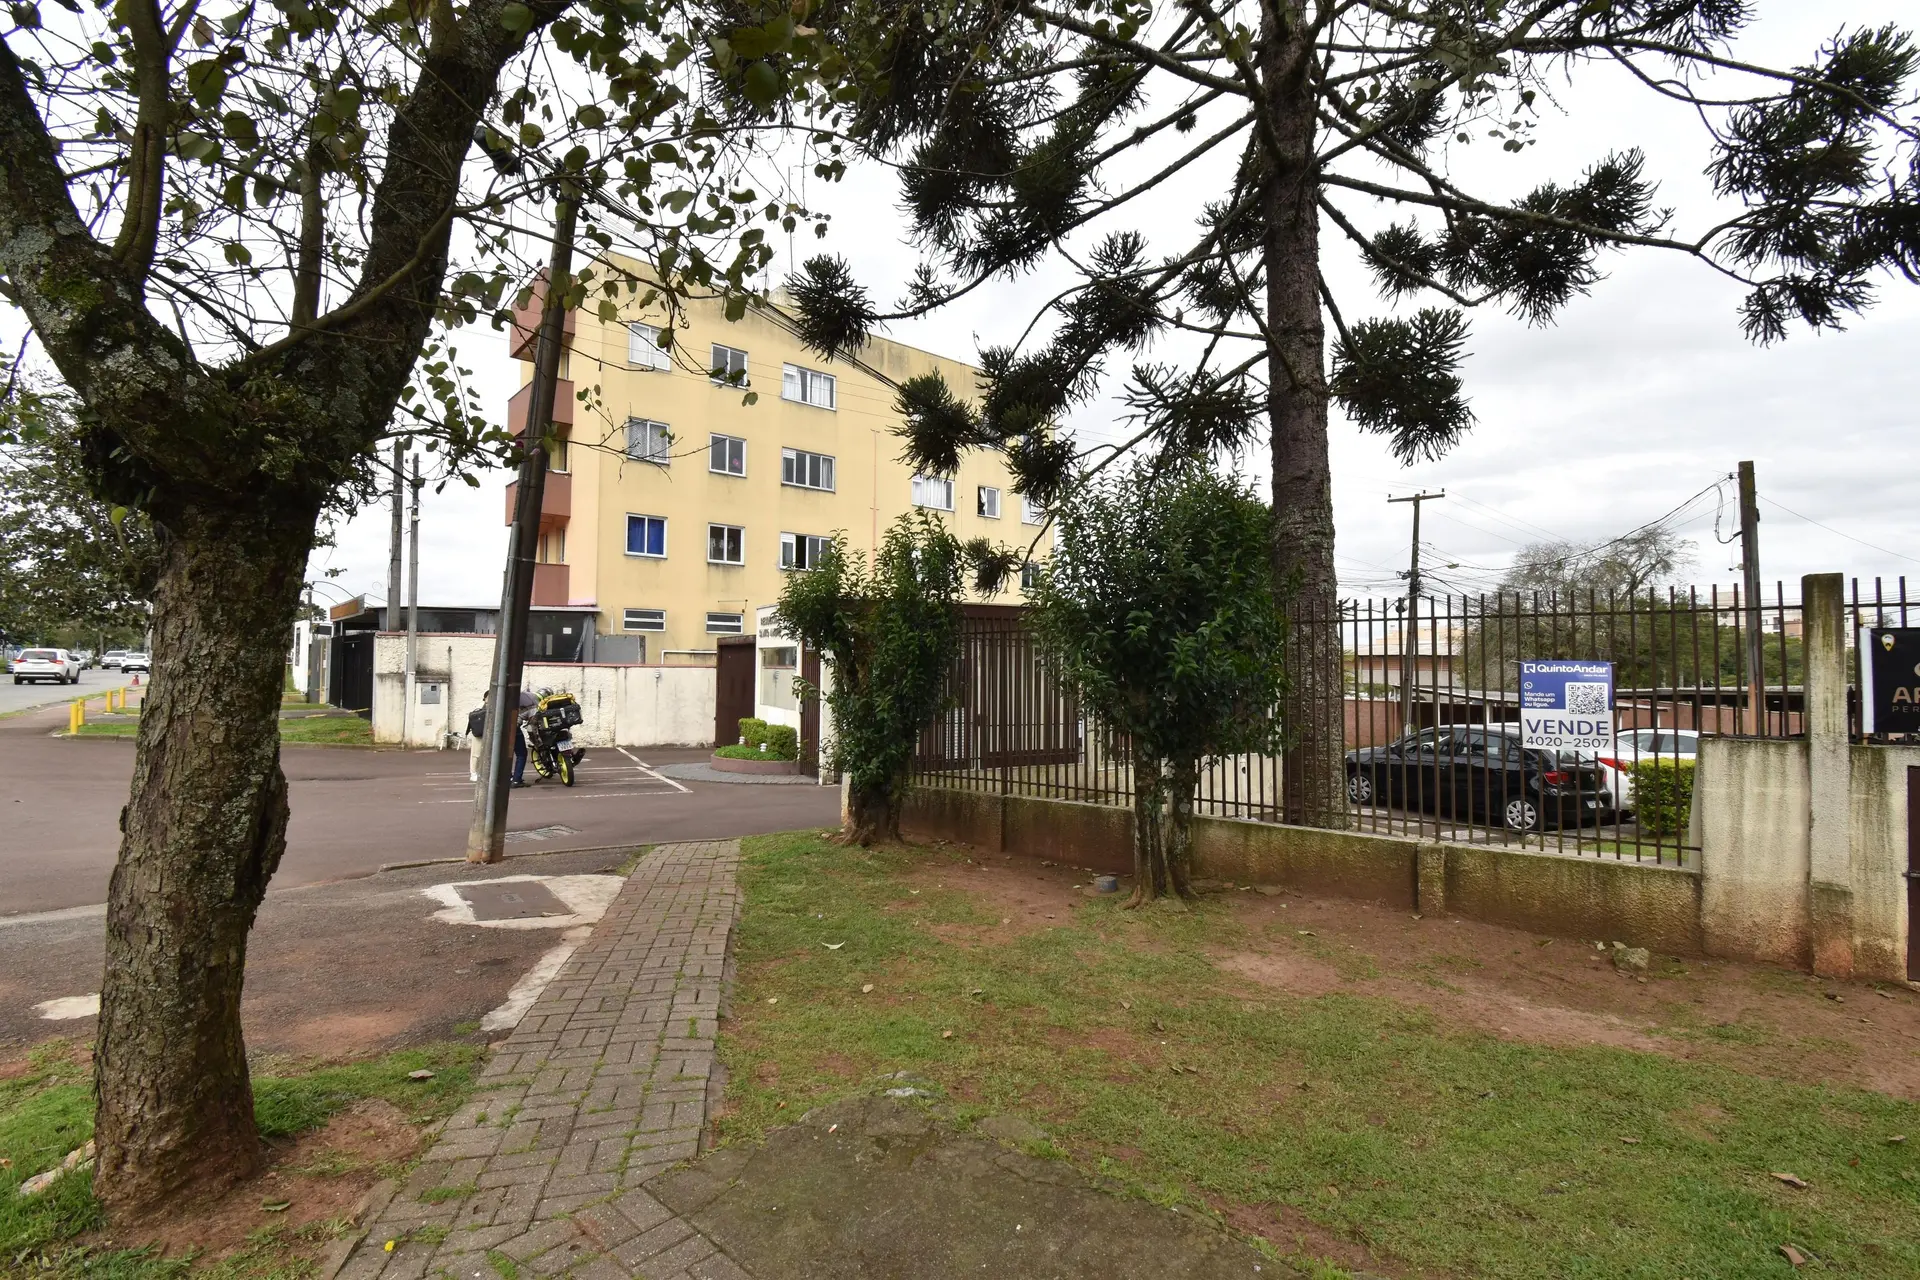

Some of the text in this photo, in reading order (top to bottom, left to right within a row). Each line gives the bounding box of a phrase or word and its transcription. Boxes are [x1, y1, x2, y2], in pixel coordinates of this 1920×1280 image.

[1537, 664, 1608, 673] QuintoAndar
[1526, 719, 1609, 736] VENDE
[1526, 736, 1609, 748] 4020-2507
